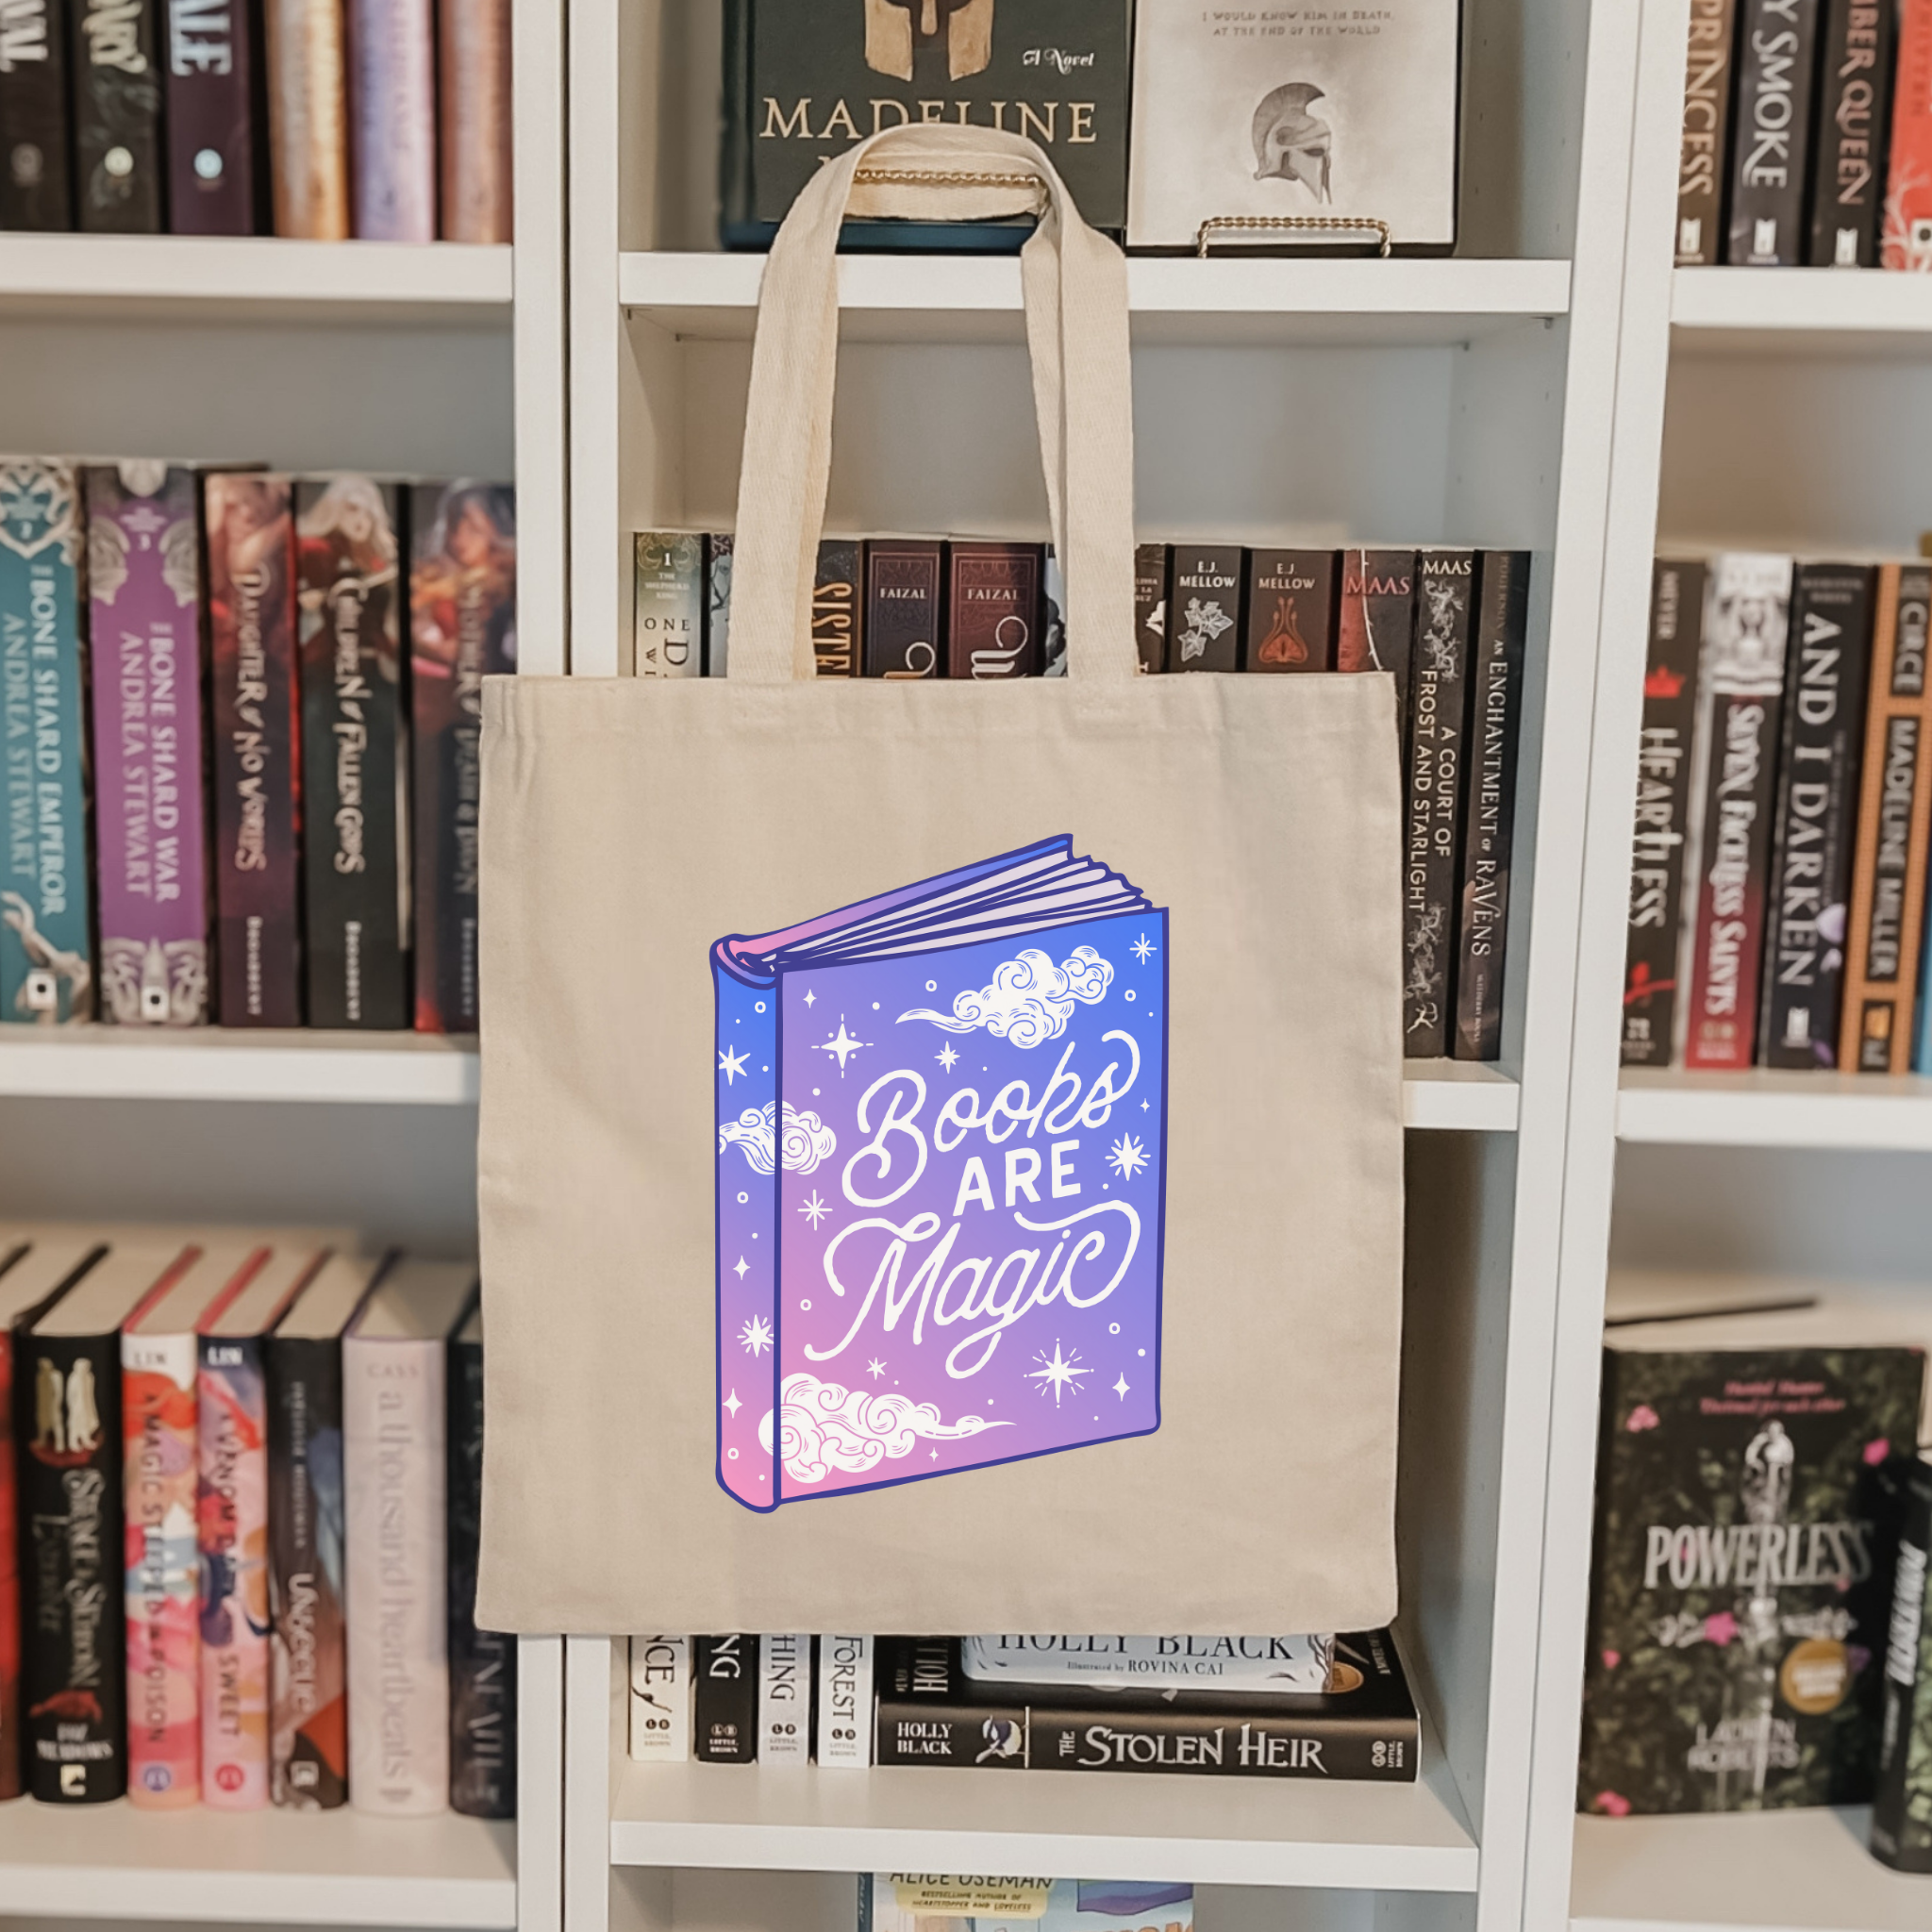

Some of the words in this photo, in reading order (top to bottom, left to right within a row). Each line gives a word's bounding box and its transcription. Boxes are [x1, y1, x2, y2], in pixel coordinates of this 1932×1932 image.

[1023, 49, 1041, 66] A
[1043, 47, 1095, 75] Novel
[1234, 26, 1256, 36] THE
[1838, 0, 1878, 78] BER
[1741, 29, 1799, 189] SMOKE
[1836, 79, 1873, 206] QUEEN
[664, 552, 673, 567] 1
[879, 588, 927, 600] FAIZAL
[967, 588, 1020, 601] FAIZAL
[1179, 575, 1236, 588] MELLOW
[1197, 561, 1219, 573] E.J.
[1258, 577, 1316, 590] MELLOW
[1346, 576, 1410, 595] MAAS
[1423, 560, 1473, 575] MAAS
[30, 579, 58, 659] BONE
[644, 617, 691, 631] ONE
[812, 582, 853, 676] SISTE
[1493, 639, 1505, 655] AN
[1892, 601, 1928, 691] CIRCE
[4, 613, 30, 738] ANDREA
[120, 631, 147, 756] ANDREA
[149, 638, 176, 716] BONE
[1797, 611, 1841, 724] AND
[33, 669, 62, 774] SHARD
[1418, 671, 1438, 738] FROST
[1441, 726, 1457, 741] A
[152, 726, 178, 829] SHARD
[1414, 745, 1433, 791] AND
[1437, 748, 1456, 821] COURT
[1479, 662, 1508, 834] ENCHANTMENT
[1795, 747, 1832, 761] I
[8, 747, 37, 879] STEWART
[123, 765, 152, 896] STEWART
[1434, 827, 1451, 857] OF
[1628, 726, 1684, 928] HEARTLESS
[155, 836, 181, 903] WAR
[1409, 800, 1430, 912] STARLIGHT
[1779, 784, 1829, 986] DARKEN
[1471, 859, 1502, 957] RAVENS
[841, 1029, 1141, 1208] Books
[953, 1139, 1082, 1217] ARE
[804, 1200, 1141, 1379] Magic
[133, 1351, 168, 1365] LIN
[208, 1346, 243, 1366] LIN
[378, 1424, 413, 1585] thousand
[1644, 1522, 1874, 1591] POWERLESS
[829, 1636, 863, 1722] FOREST
[1128, 1658, 1191, 1674] ROVINA
[1194, 1662, 1224, 1675] CAI
[1156, 1636, 1294, 1659] BLACK
[218, 1655, 241, 1737] SWEET
[379, 1598, 415, 1778] heartbeats
[897, 1740, 953, 1755] BLACK
[899, 1722, 953, 1739] HOLLY
[1058, 1731, 1075, 1757] THE
[1077, 1725, 1224, 1766] STOLEN
[1238, 1723, 1328, 1774] HEIR
